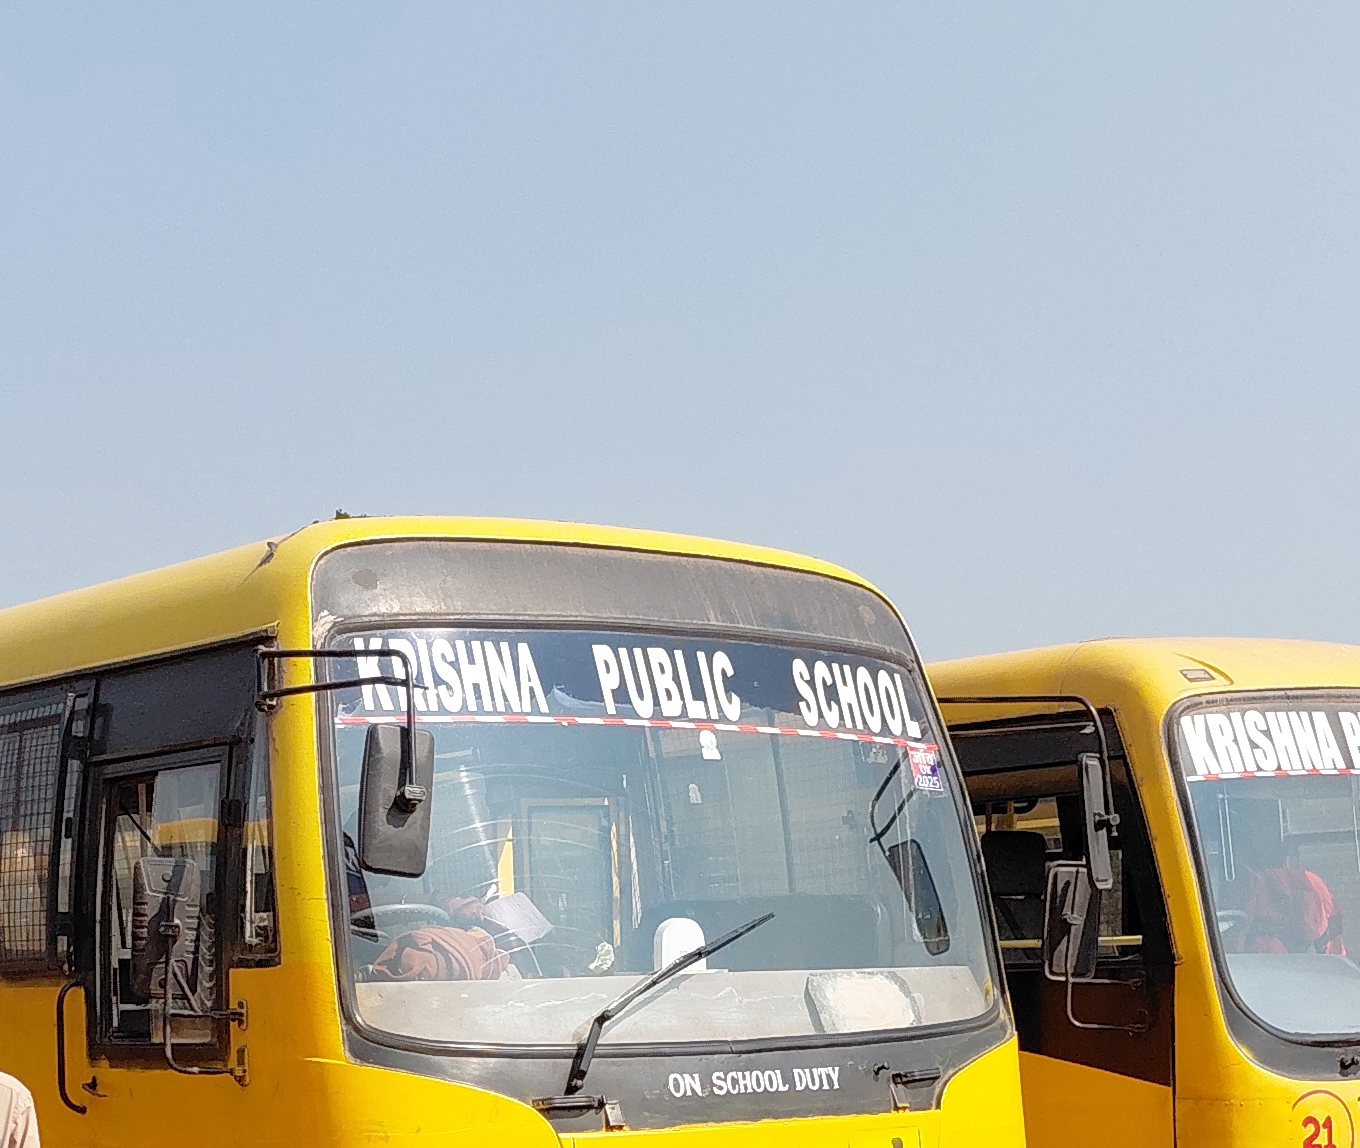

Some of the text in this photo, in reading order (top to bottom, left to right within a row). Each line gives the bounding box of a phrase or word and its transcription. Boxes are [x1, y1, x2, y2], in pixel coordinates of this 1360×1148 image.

[353, 637, 922, 739] KRISHNA PUBLIC SCHOOL
[1180, 710, 1344, 772] KRISHNA
[667, 1066, 842, 1097] ON SCHOOL DUTY
